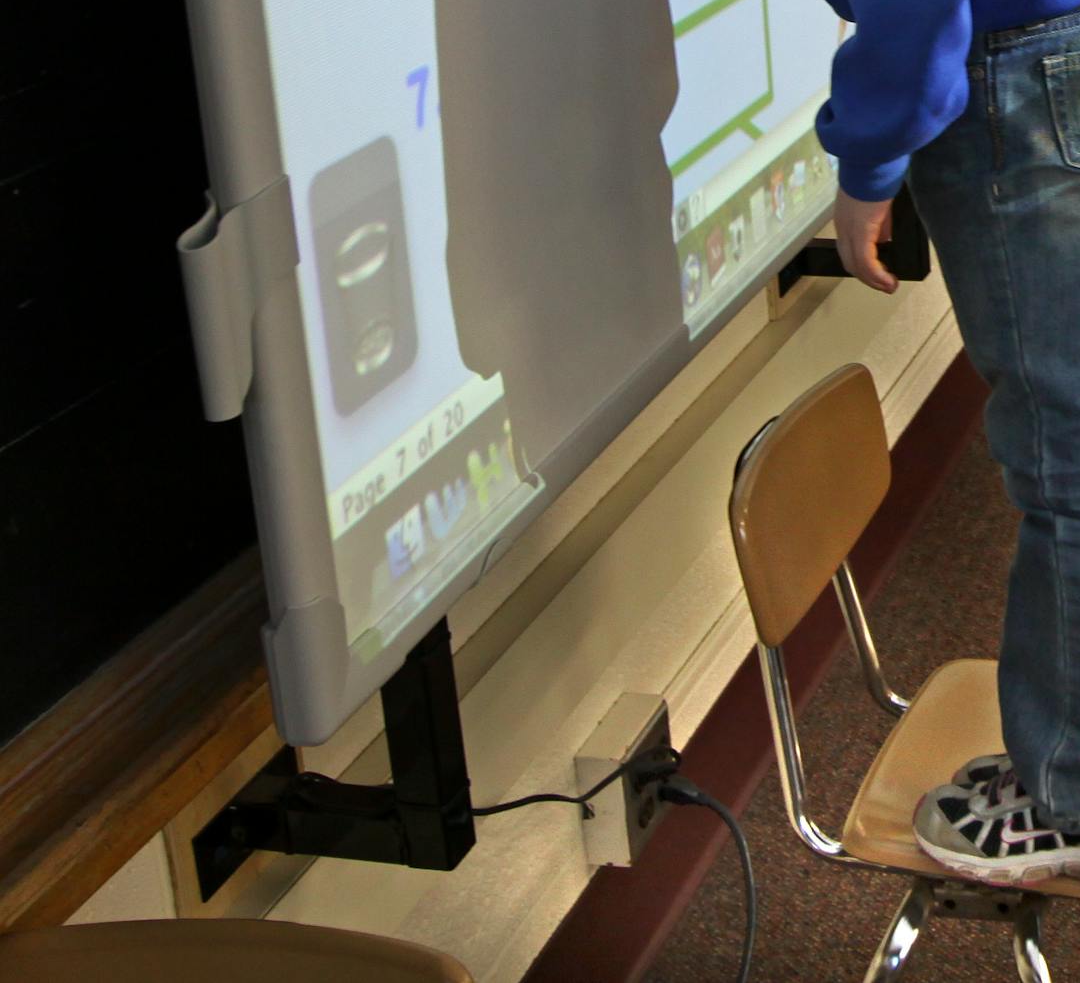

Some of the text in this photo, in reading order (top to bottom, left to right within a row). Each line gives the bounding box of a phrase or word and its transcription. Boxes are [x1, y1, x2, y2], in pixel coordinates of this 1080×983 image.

[340, 400, 465, 525] Page 7 of 20
